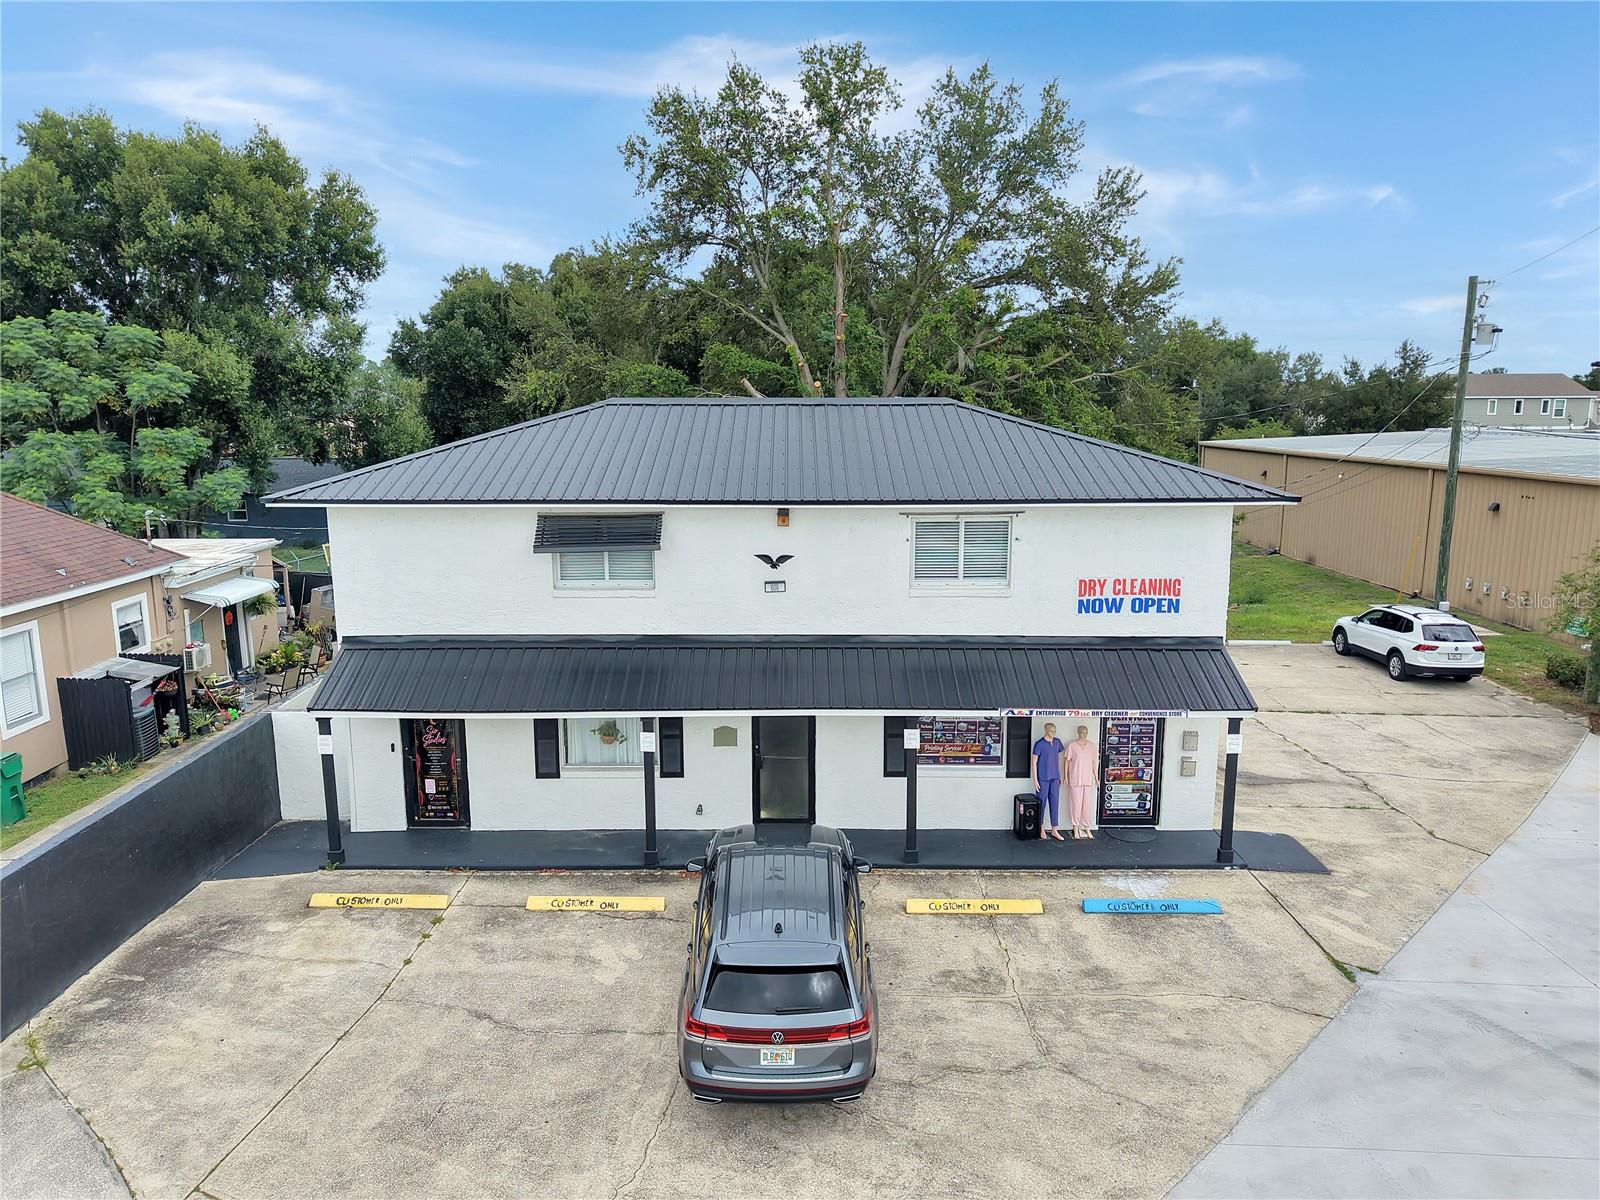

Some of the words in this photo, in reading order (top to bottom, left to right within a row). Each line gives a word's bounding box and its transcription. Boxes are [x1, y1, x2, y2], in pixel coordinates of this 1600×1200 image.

[1078, 578, 1107, 597] DRY
[1112, 578, 1182, 597] CLEANING
[1078, 598, 1124, 614] NOW
[1131, 598, 1180, 613] OPEN
[924, 744, 943, 752] Printing
[944, 744, 961, 752] Services
[336, 896, 380, 905] CUSTOMER
[384, 898, 403, 906] ONLY
[551, 899, 594, 908] CUSTOMER
[600, 901, 620, 910] ONLY
[928, 902, 972, 911] CUSTOMER
[980, 903, 1000, 911] ONLY
[1107, 902, 1151, 911] CUSTOMER
[1160, 903, 1179, 912] ONLY
